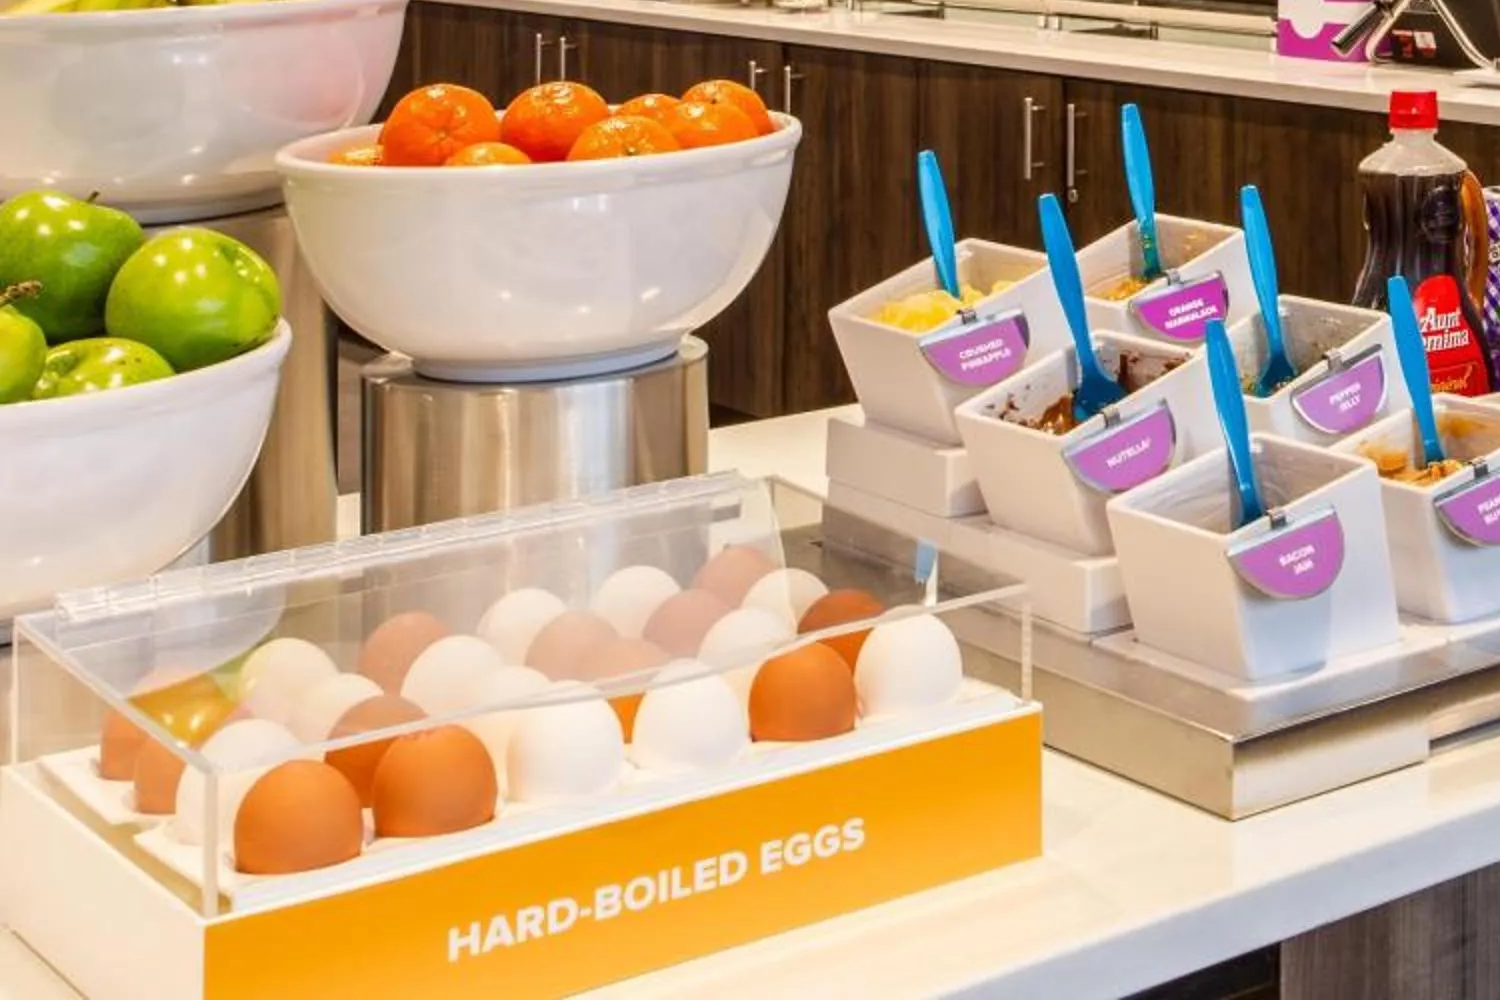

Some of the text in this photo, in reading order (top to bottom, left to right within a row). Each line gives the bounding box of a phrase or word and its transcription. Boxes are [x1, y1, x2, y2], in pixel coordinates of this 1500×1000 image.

[1420, 306, 1462, 333] Aunt
[1279, 544, 1316, 568] BACON
[447, 817, 866, 963] HARD-BOILED EGGS
